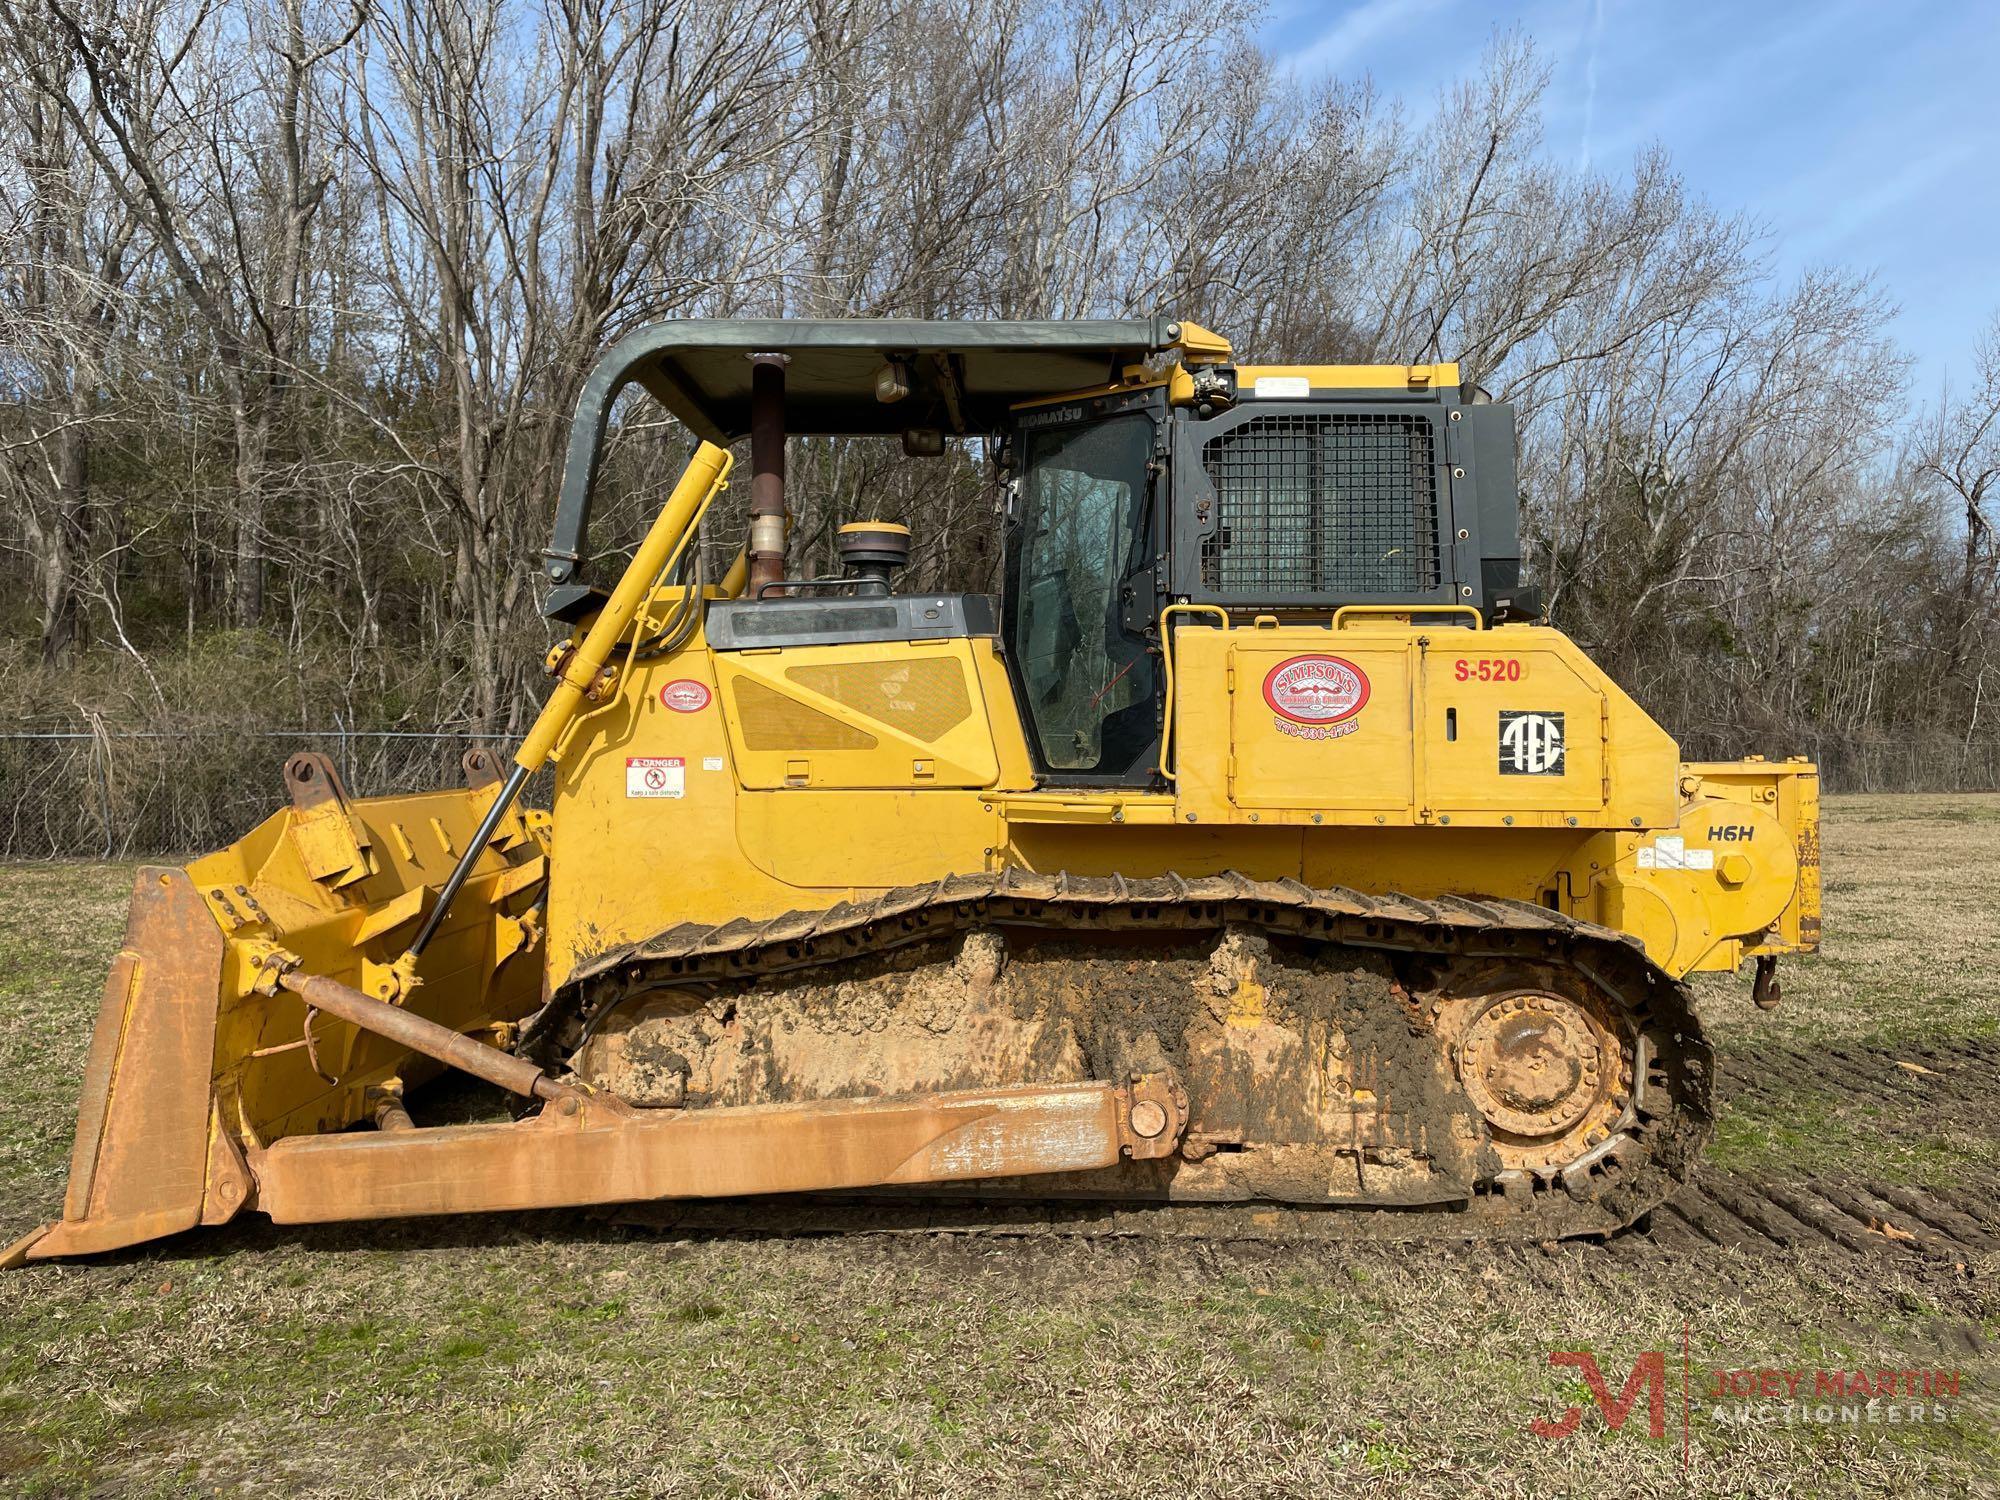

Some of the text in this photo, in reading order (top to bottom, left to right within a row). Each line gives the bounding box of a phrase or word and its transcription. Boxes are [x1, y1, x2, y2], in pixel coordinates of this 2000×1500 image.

[1277, 664, 1356, 694] SIMPSON'S
[1455, 659, 1520, 681] S-520
[1274, 716, 1359, 740] 770-536-4731
[1503, 714, 1561, 773] TEC
[642, 759, 680, 767] DANGER
[1708, 826, 1754, 841] H6H
